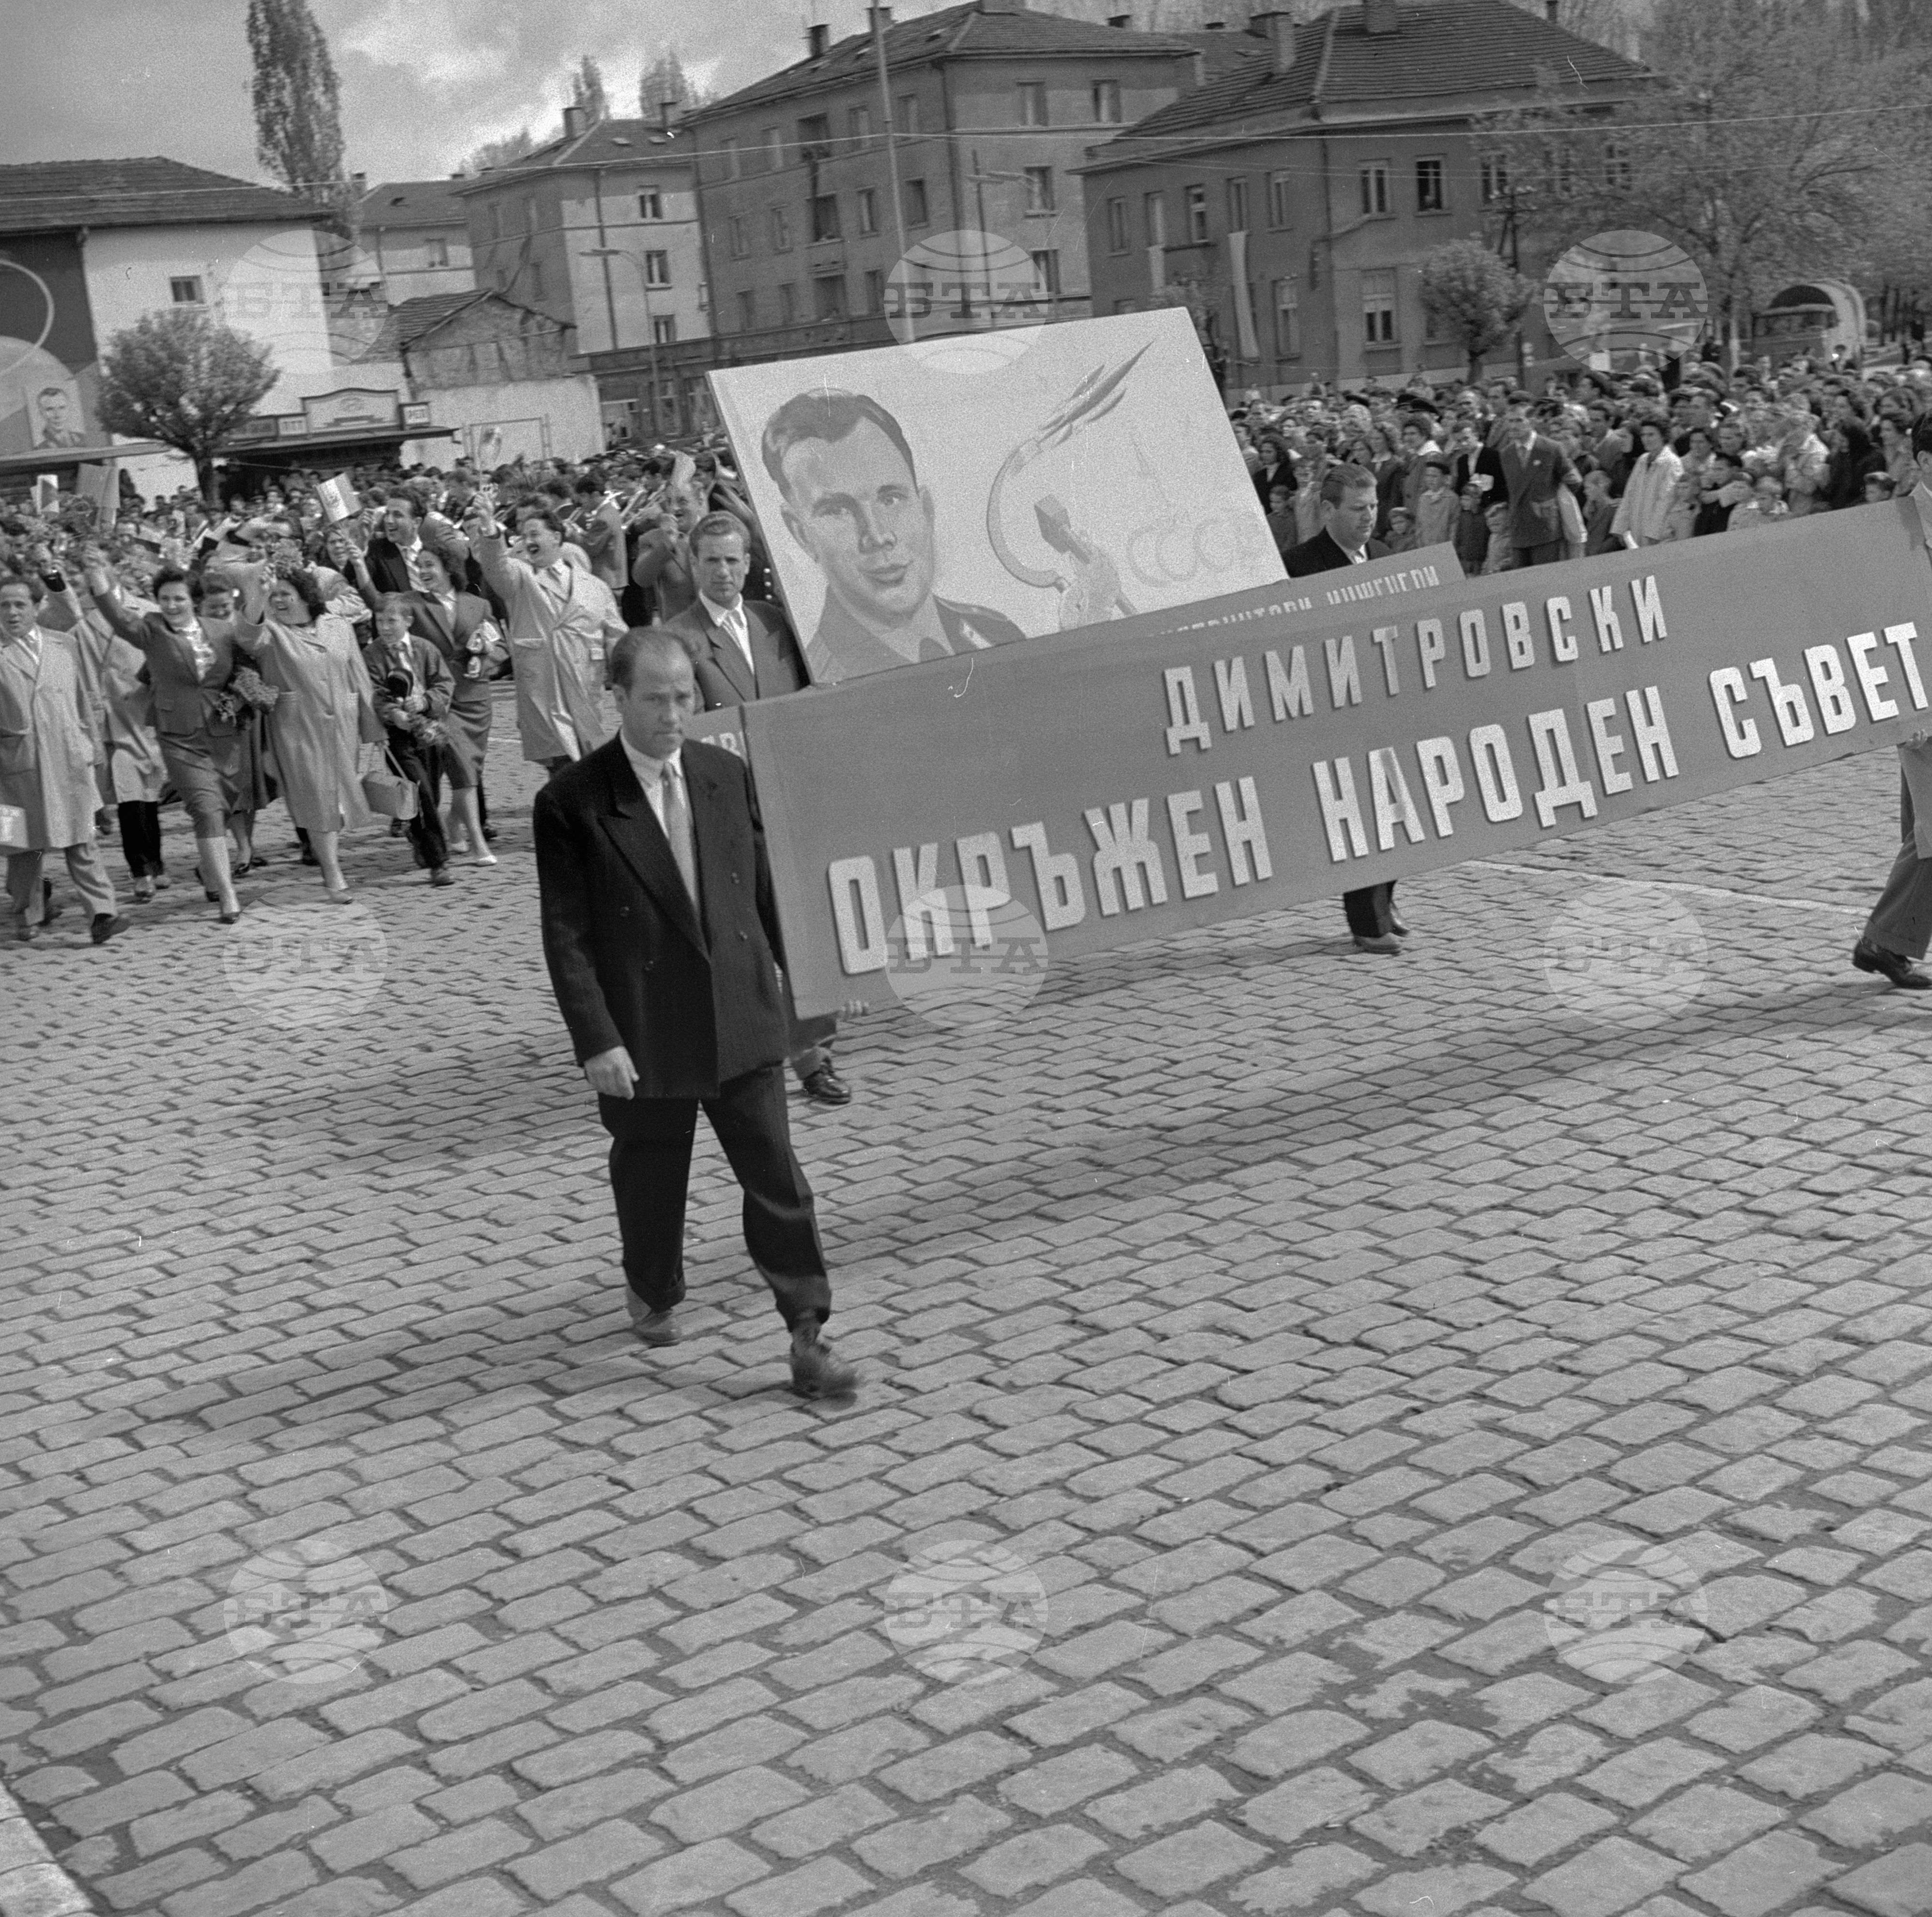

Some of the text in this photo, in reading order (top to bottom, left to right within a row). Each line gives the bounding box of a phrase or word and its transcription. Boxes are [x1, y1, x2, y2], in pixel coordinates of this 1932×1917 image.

[1164, 575, 1667, 754] ДИМИТРОВСКИ
[829, 622, 1929, 975] ОКРЪЖЕН НАРОДЕН СЪВЕТ
